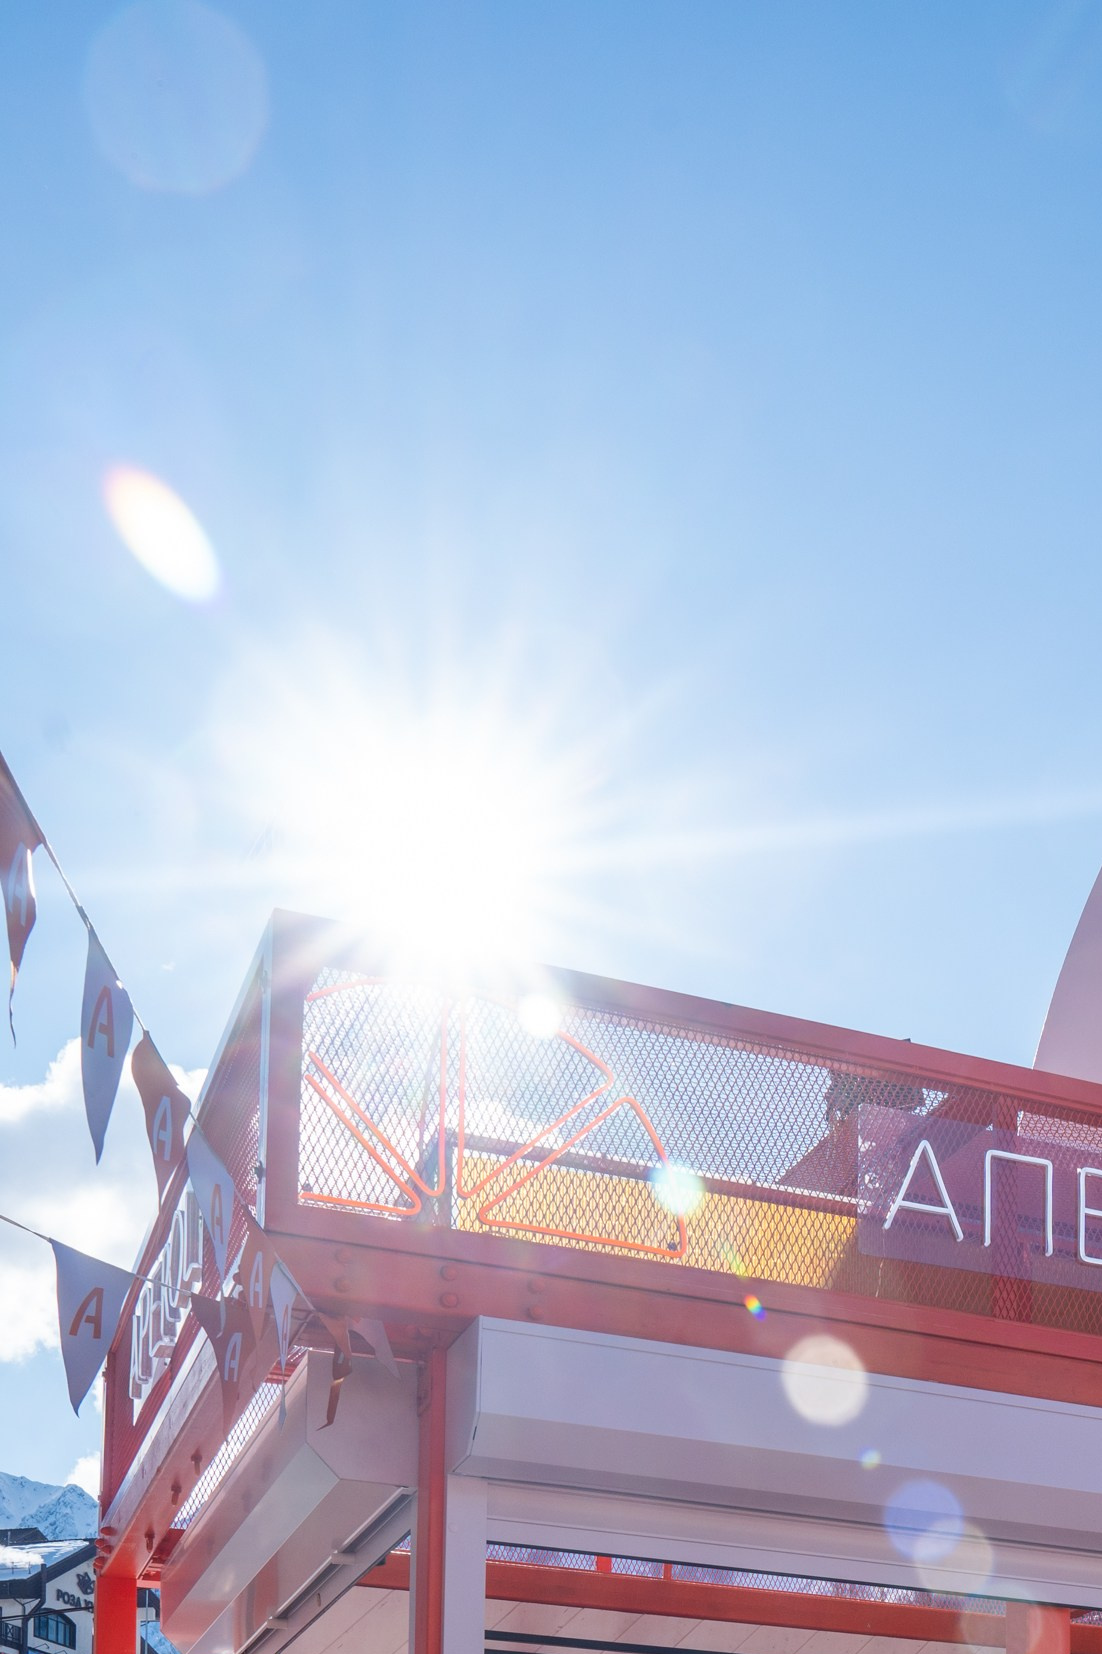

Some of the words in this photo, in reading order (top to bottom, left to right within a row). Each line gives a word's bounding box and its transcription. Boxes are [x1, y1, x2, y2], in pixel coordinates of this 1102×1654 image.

[87, 985, 115, 1058] A
[153, 1096, 173, 1162] A
[209, 1183, 224, 1246] A
[250, 1250, 263, 1309] A
[68, 1286, 104, 1340] A
[224, 1332, 243, 1384] A
